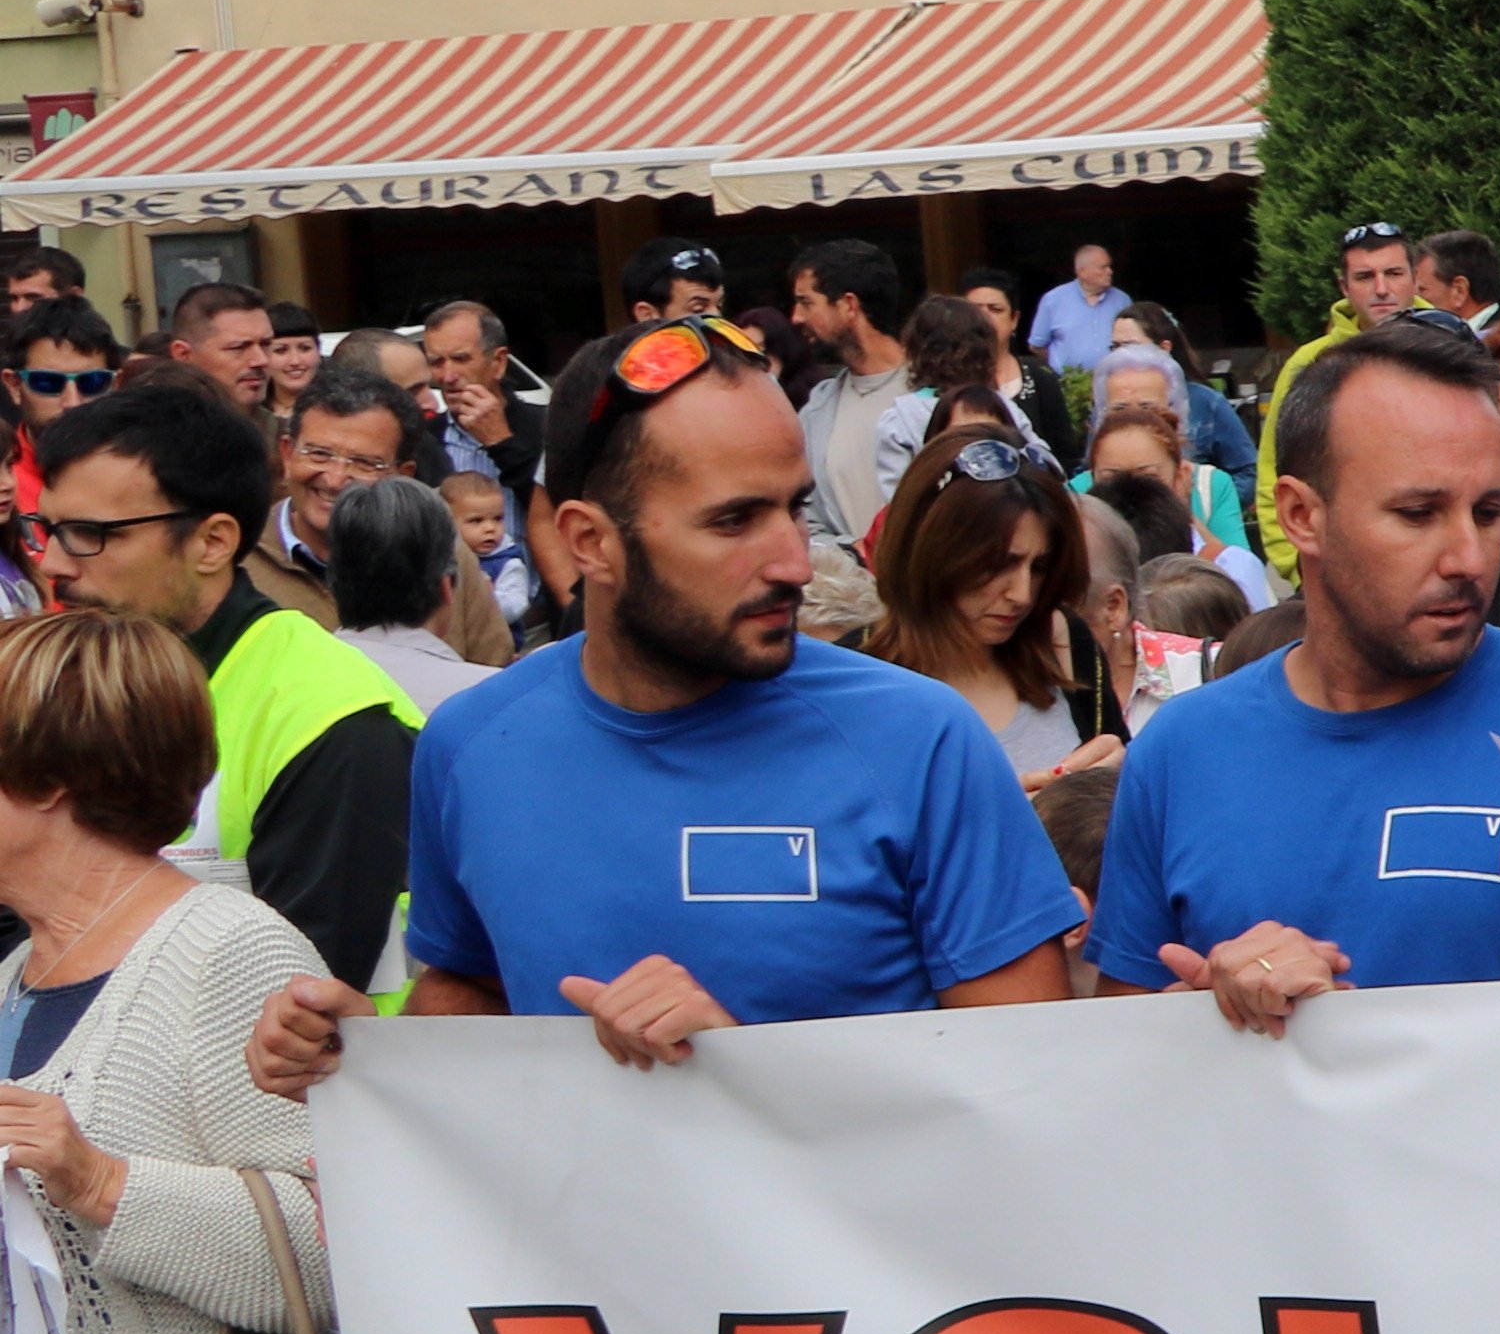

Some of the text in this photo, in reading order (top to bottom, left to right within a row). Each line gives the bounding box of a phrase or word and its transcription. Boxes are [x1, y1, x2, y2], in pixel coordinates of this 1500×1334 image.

[81, 141, 1261, 219] RESTAURANT LAS CUMB
